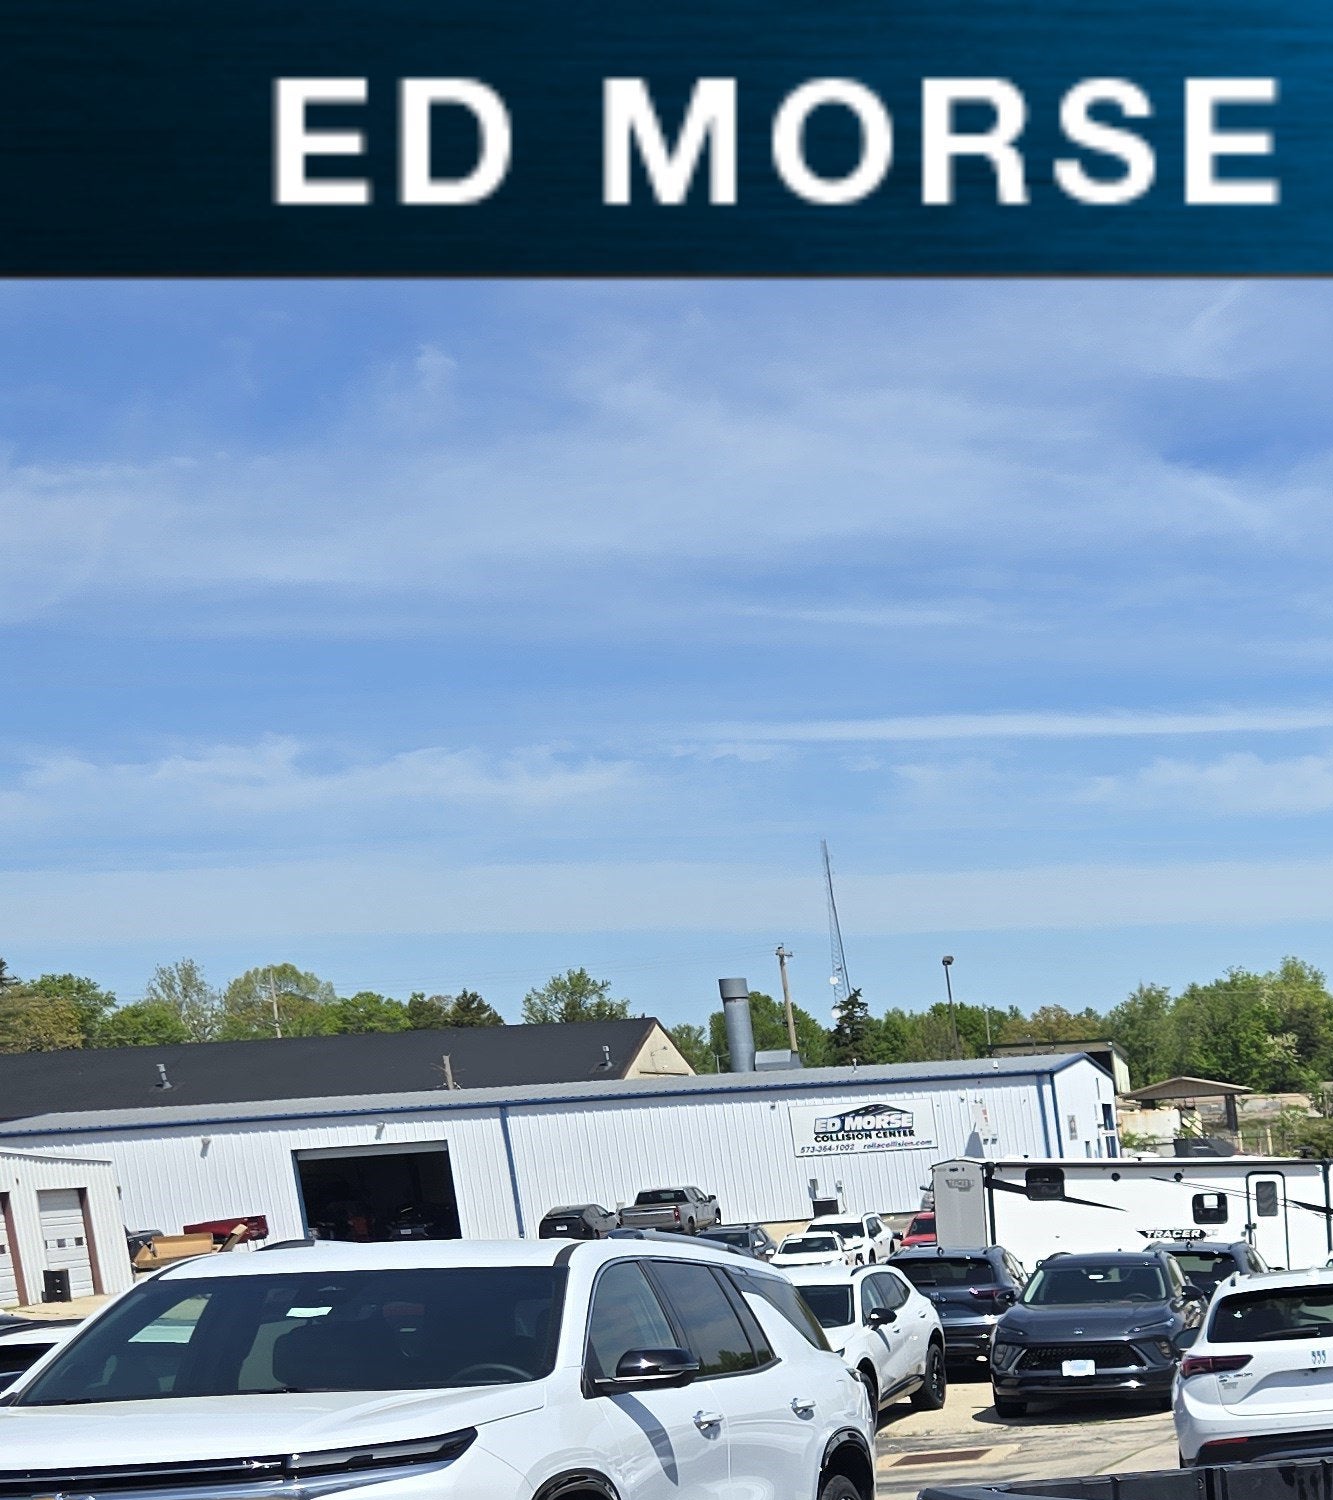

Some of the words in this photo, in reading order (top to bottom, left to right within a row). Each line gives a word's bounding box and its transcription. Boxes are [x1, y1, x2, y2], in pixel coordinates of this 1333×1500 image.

[814, 1118, 842, 1133] ED
[844, 1112, 913, 1131] MORSE
[814, 1132, 873, 1143] COLLISION
[875, 1129, 916, 1138] CENTER
[1145, 1229, 1201, 1239] TRACER
